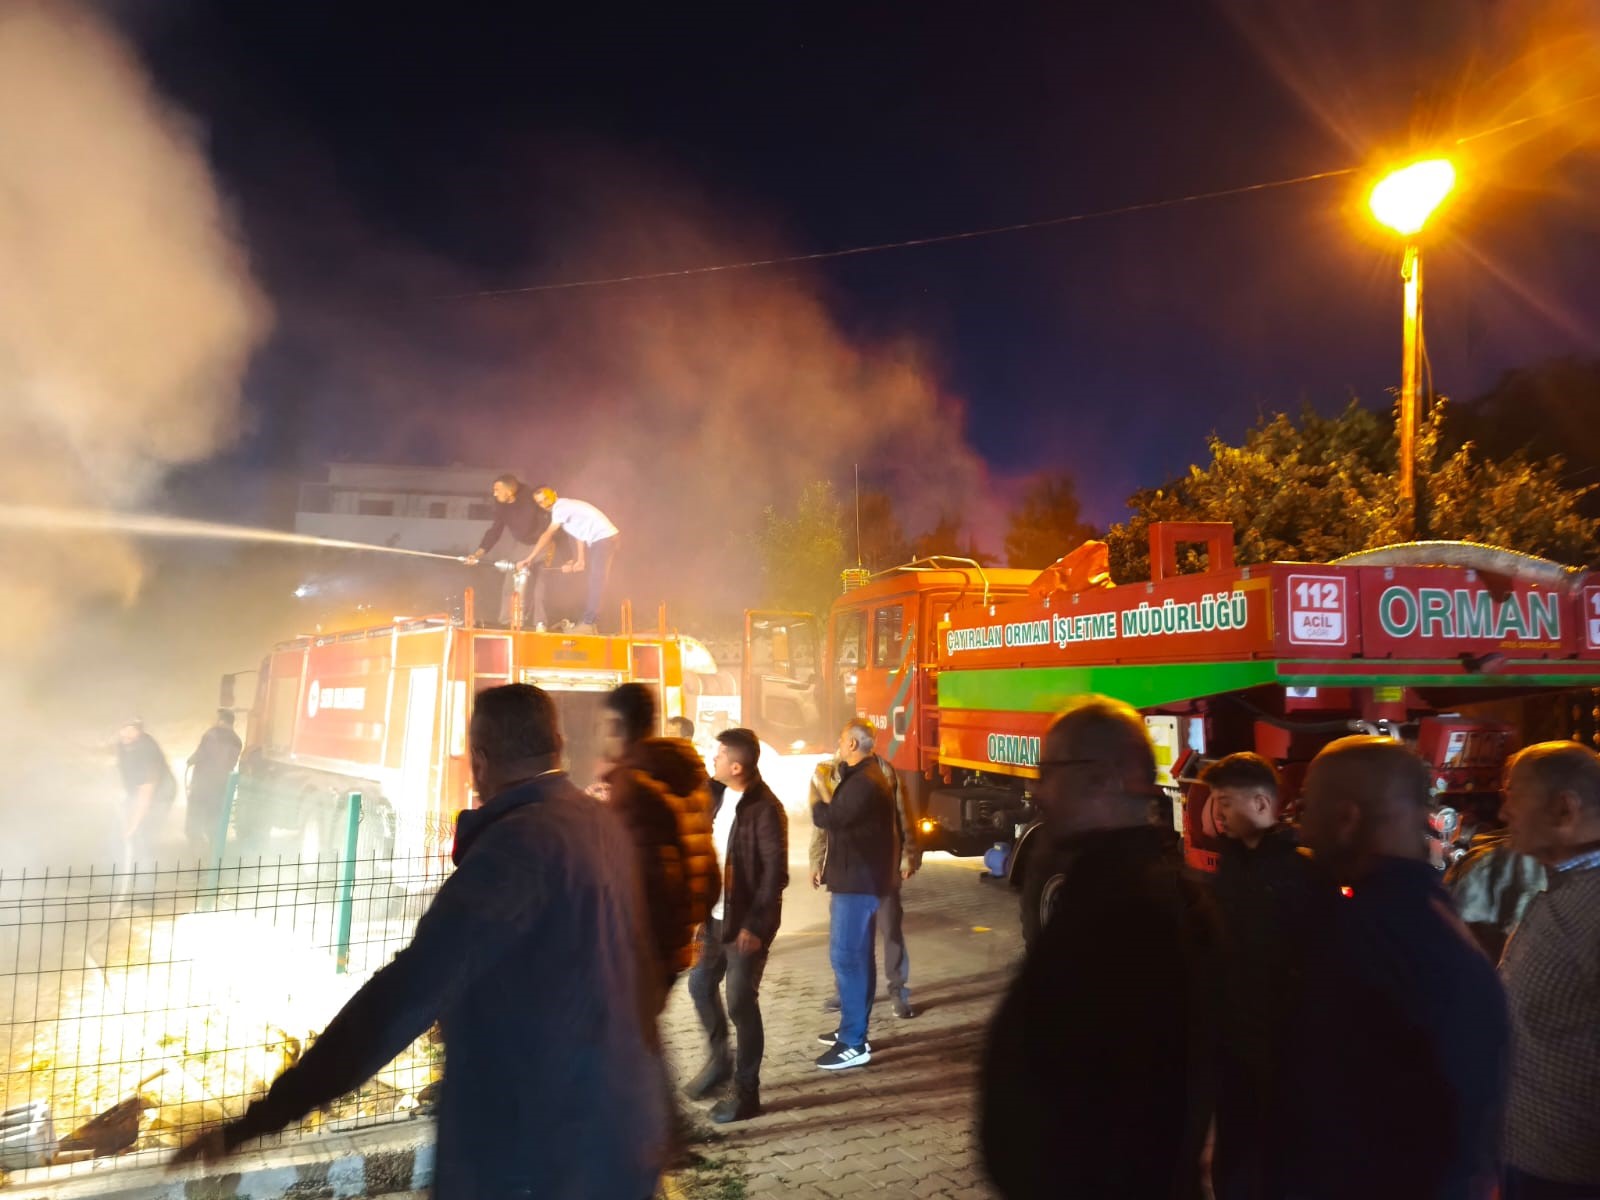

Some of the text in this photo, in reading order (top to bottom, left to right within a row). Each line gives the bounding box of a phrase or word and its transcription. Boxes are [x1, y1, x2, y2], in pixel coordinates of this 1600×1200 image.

[1295, 582, 1339, 608] 112
[946, 591, 1247, 655] ÇAYIRALAN ORMAN İŞLETME MÜDÜRLÜĞÜ
[1303, 614, 1333, 628] ACİL
[1379, 585, 1561, 640] ORMAN
[987, 733, 1041, 767] ORMAN
